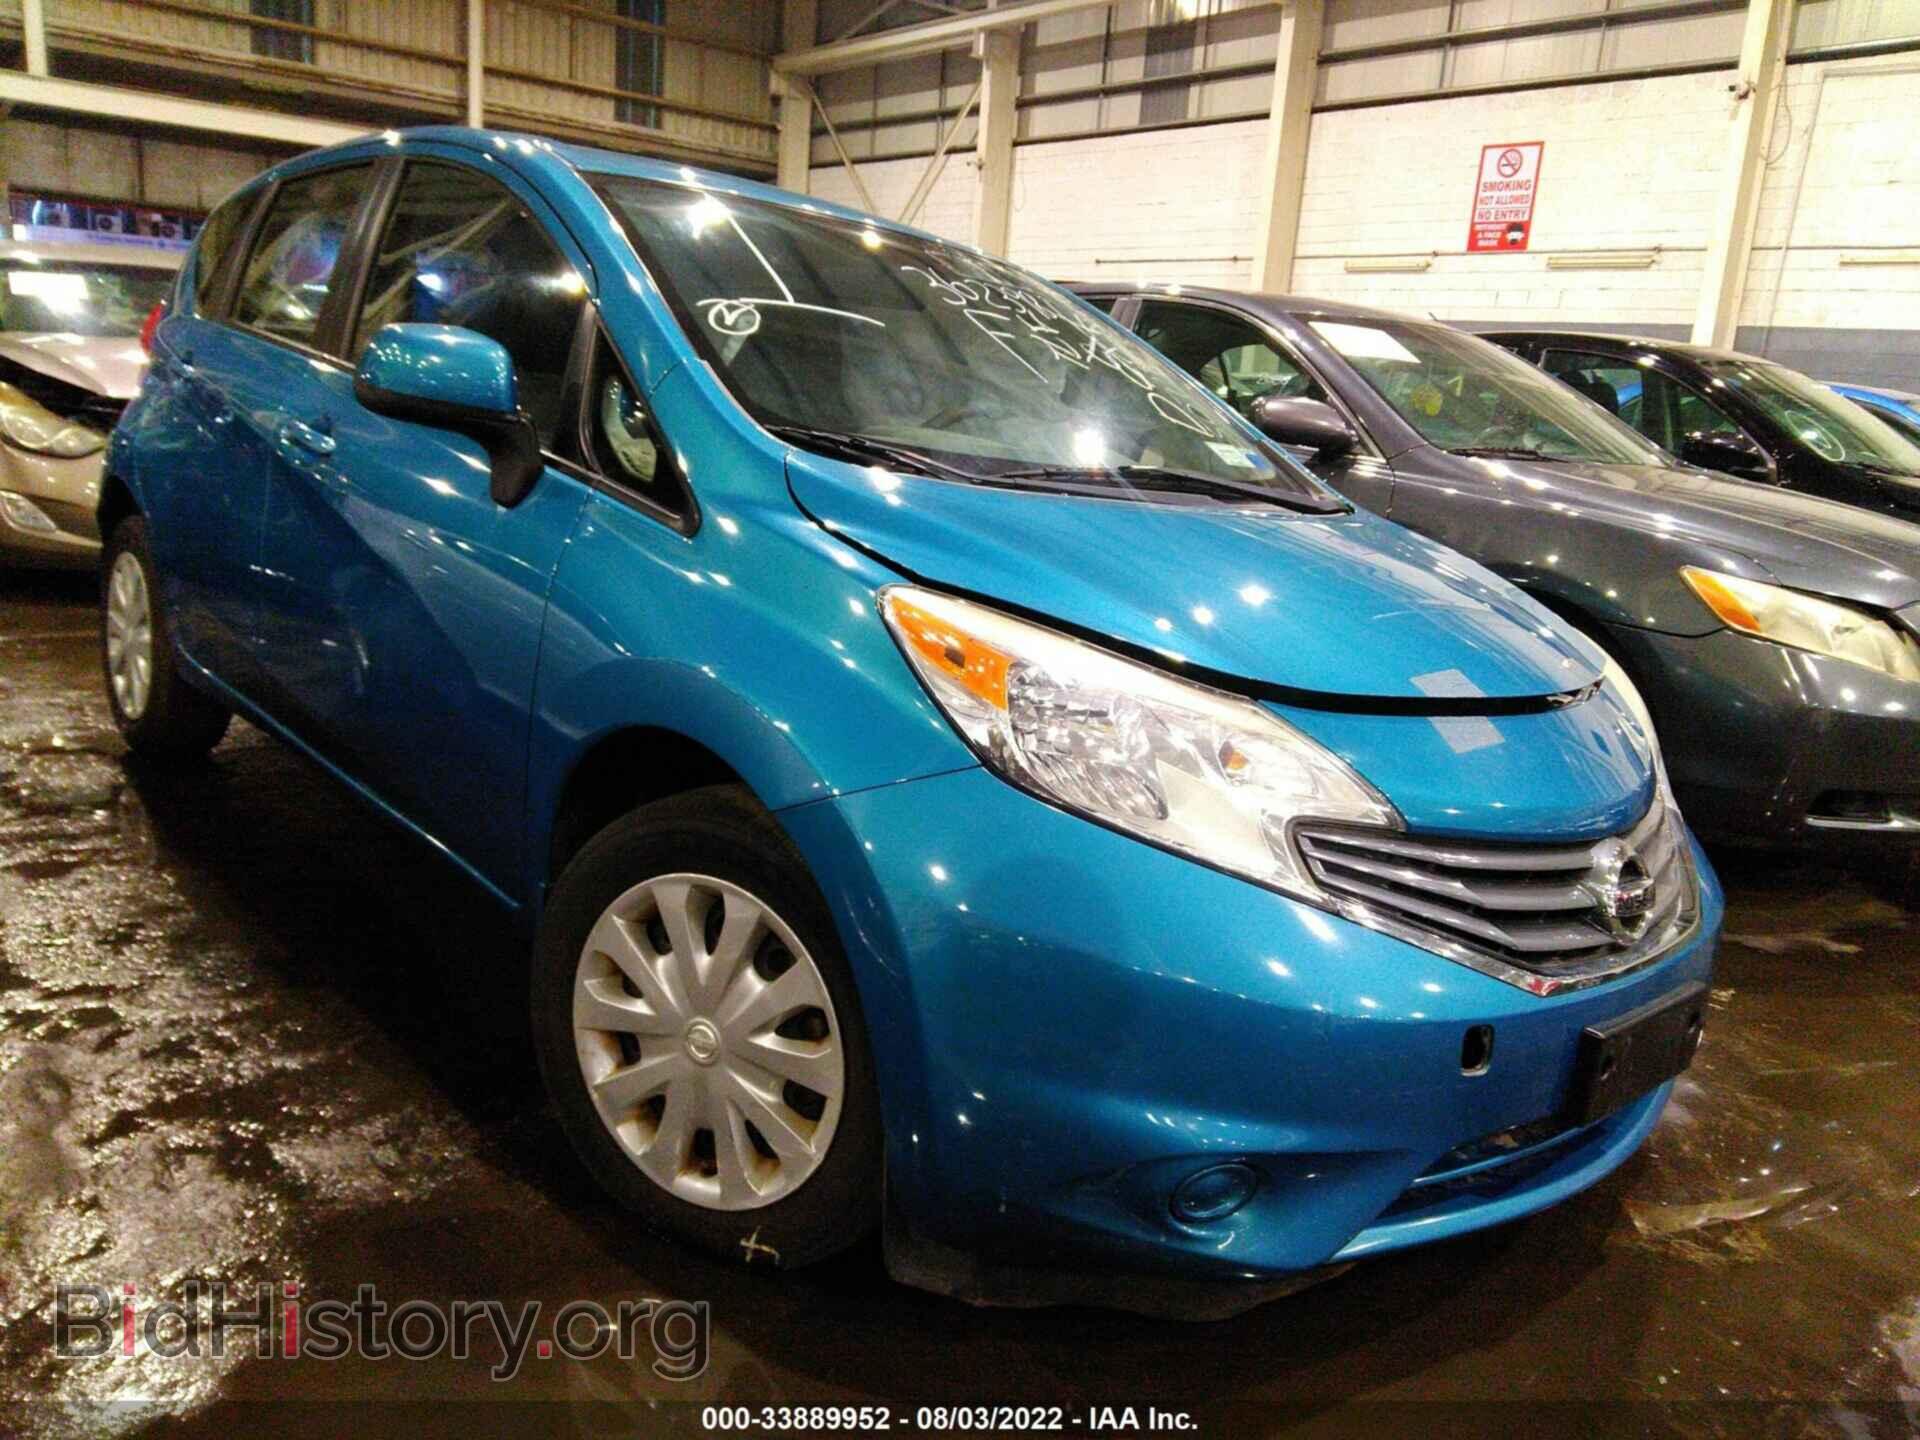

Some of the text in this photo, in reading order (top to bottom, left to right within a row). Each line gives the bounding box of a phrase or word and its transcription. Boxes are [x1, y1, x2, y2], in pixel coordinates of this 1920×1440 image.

[1481, 179, 1532, 193] SMOKING
[1479, 194, 1530, 206] NOT ALLOWED
[1477, 209, 1527, 220] NO ENTRY
